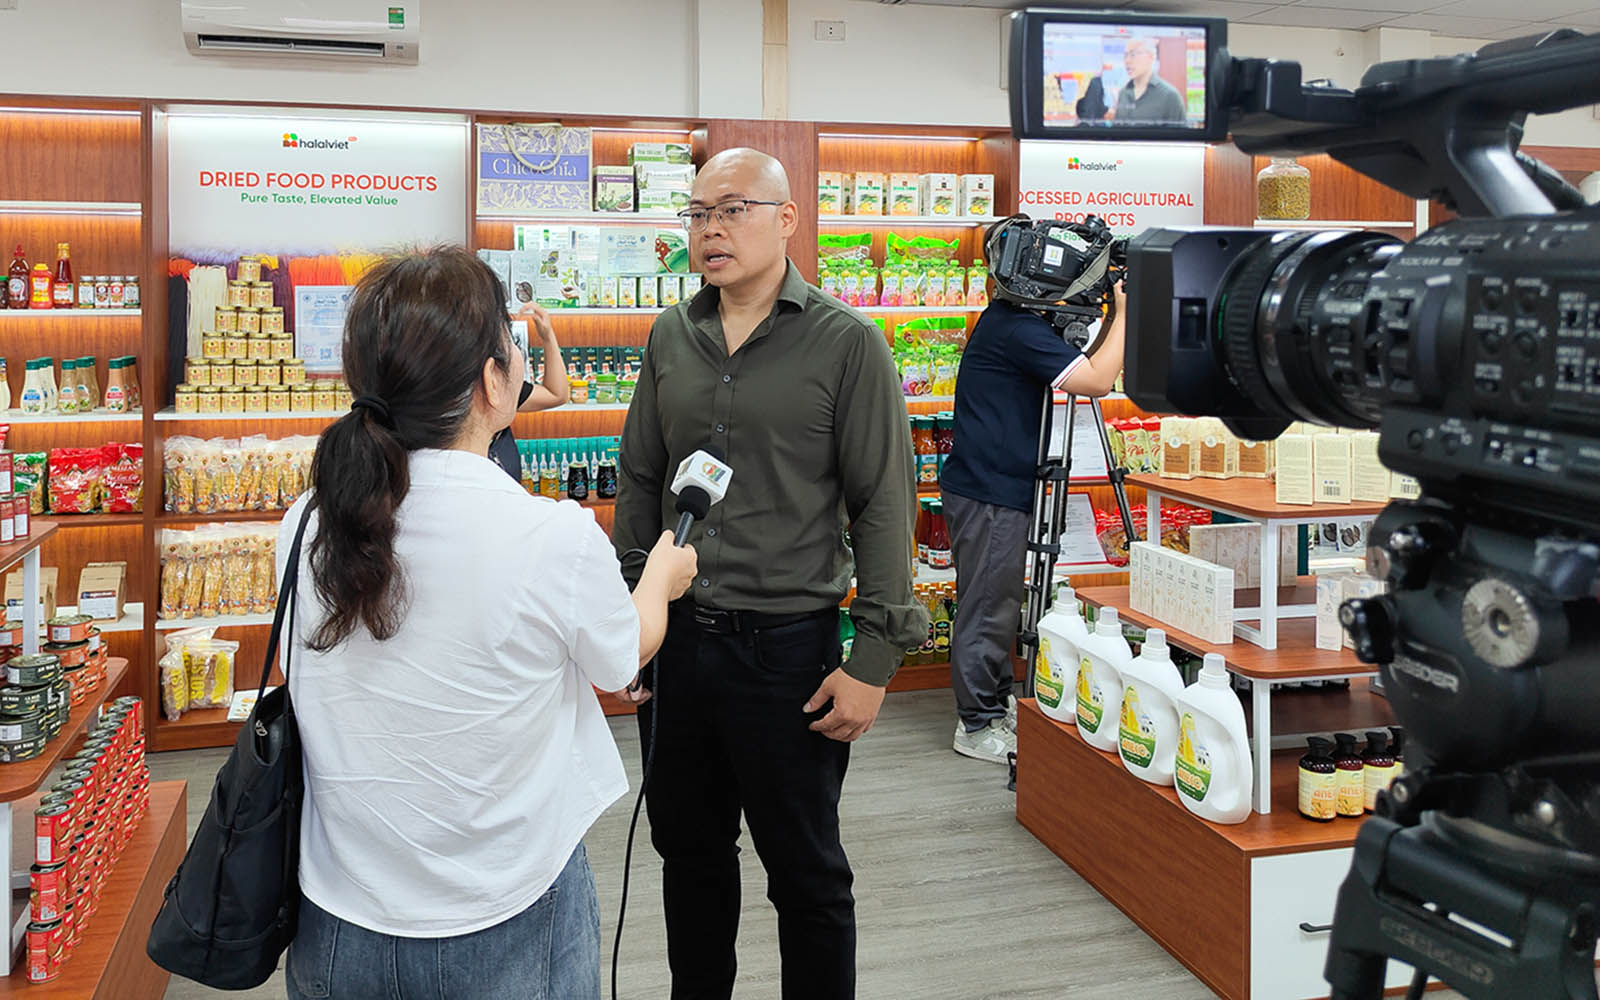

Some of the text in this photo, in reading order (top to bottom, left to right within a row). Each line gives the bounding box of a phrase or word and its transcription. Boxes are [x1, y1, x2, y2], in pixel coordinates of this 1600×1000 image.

[299, 138, 349, 150] halalviet
[1080, 161, 1117, 171] halalviet
[199, 171, 438, 192] DRIED FOOD PRODUCTS
[240, 192, 399, 206] Pure Taste, Elevated Value
[1085, 191, 1194, 207] AGRICULTURAL
